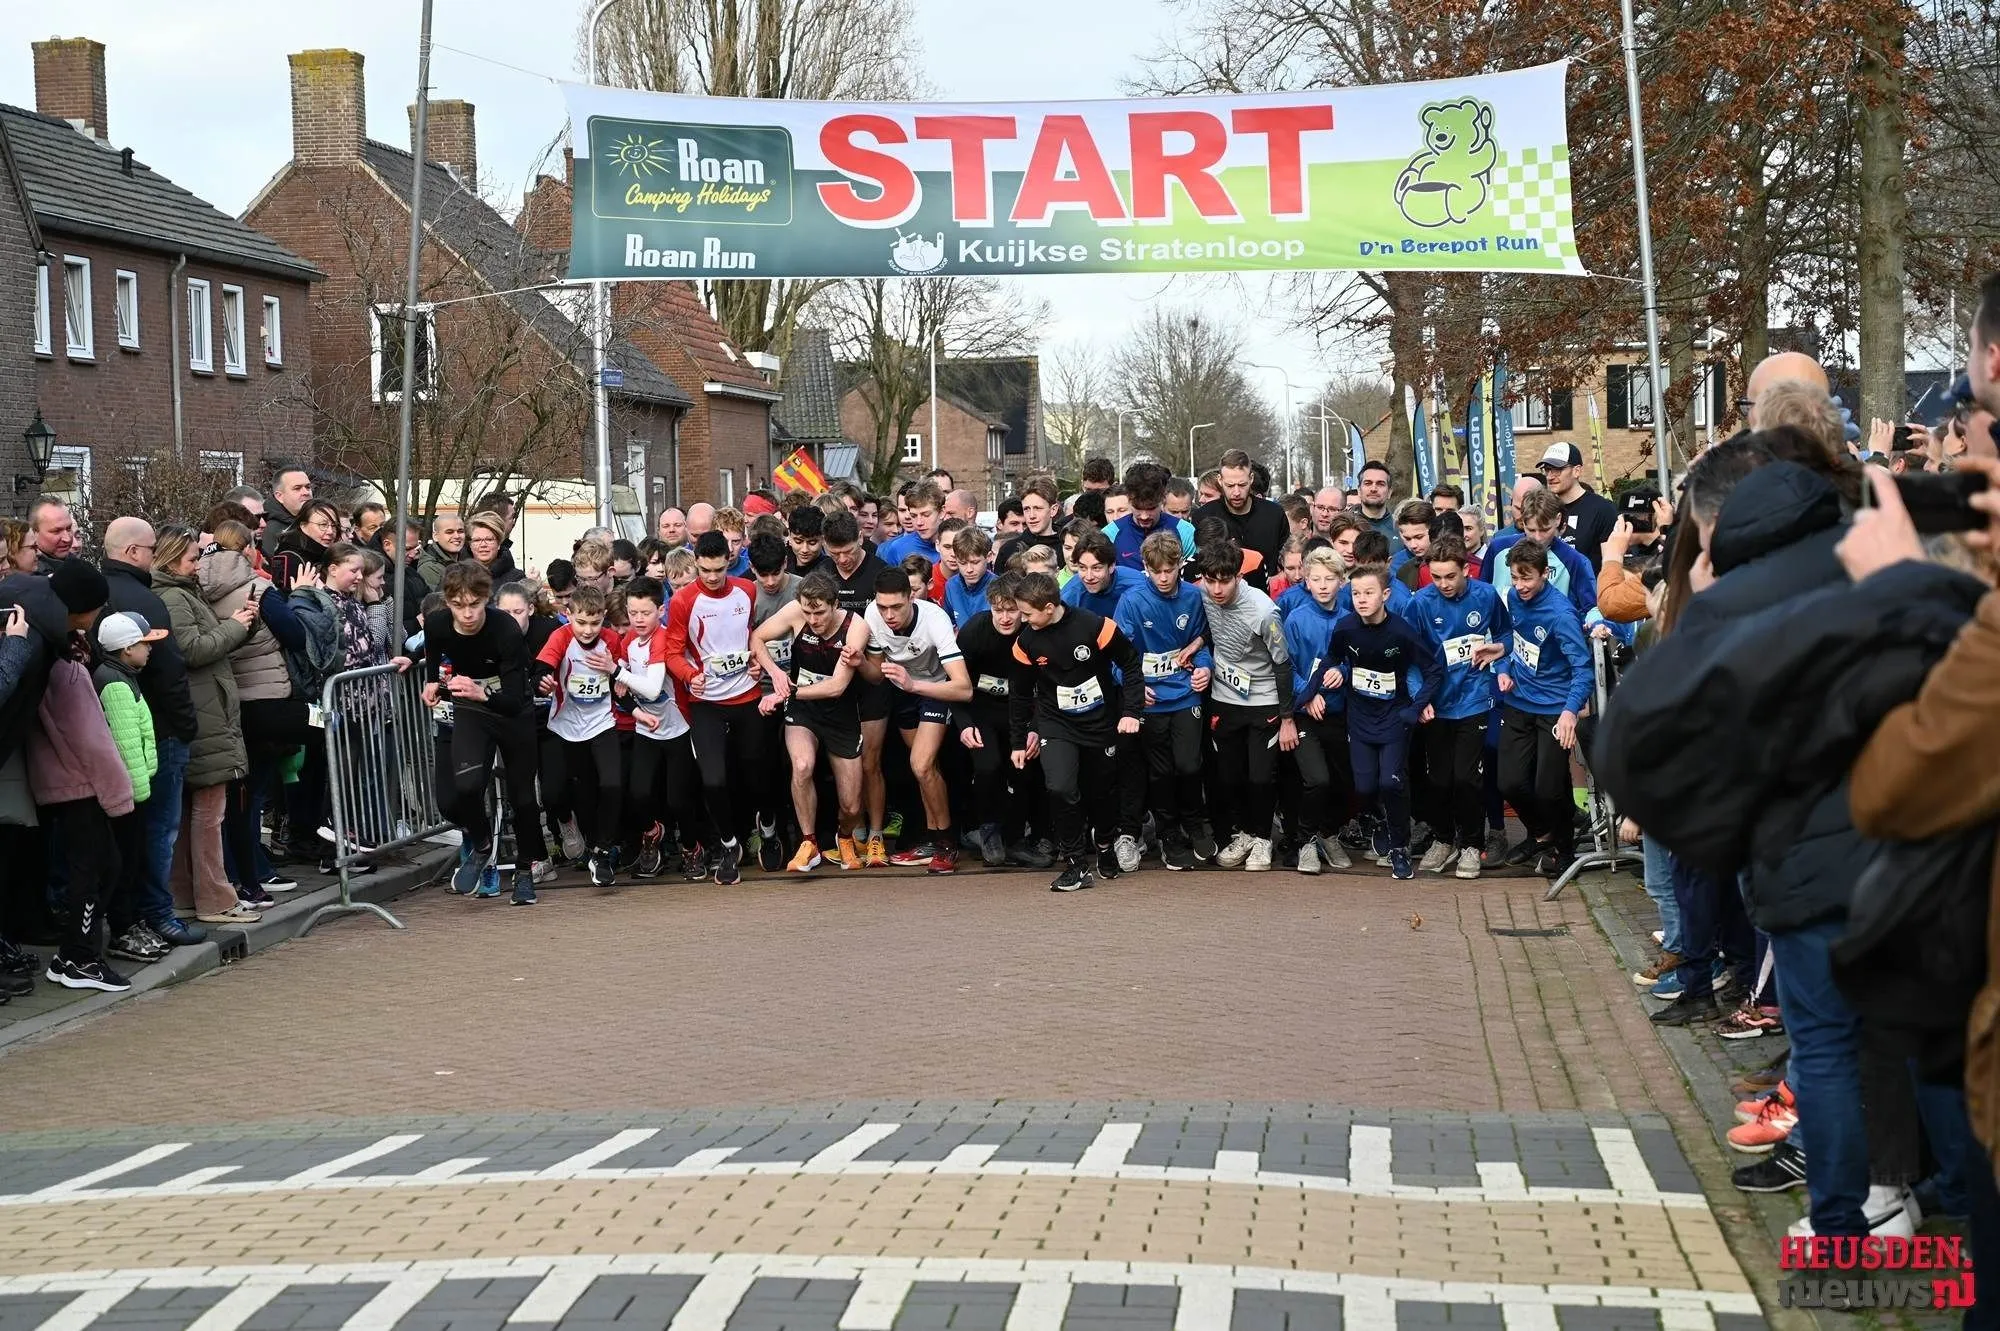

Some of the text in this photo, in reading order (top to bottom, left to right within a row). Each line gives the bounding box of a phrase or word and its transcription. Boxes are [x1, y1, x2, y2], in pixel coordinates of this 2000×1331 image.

[677, 138, 765, 185] Roan
[816, 105, 1333, 228] START
[625, 183, 771, 213] Camping Holidays
[625, 233, 756, 269] Roan Run
[959, 236, 1305, 267] Kuijkse Stratenloop
[1359, 235, 1539, 255] D'n Berepot Run
[1470, 416, 1484, 476] roan
[1457, 644, 1472, 659] 97
[1518, 644, 1529, 662] 113
[721, 655, 744, 672] 194
[1153, 661, 1173, 674] 114
[1221, 670, 1240, 687] 110
[1365, 678, 1381, 690] 75
[578, 683, 601, 695] 251
[1070, 693, 1088, 706] 76
